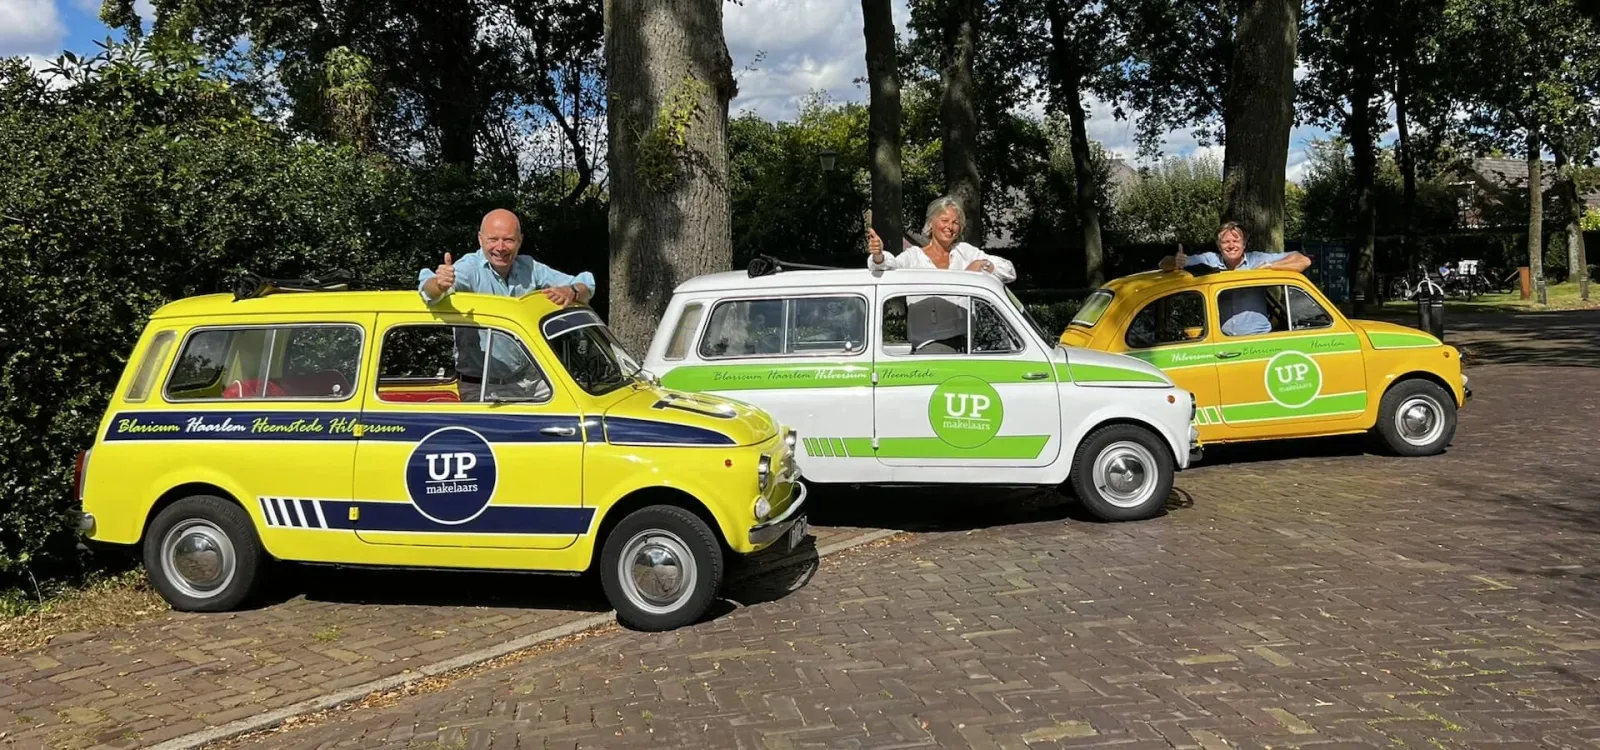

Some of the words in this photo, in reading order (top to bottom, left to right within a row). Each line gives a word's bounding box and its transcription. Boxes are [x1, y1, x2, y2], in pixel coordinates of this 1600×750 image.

[1171, 353, 1214, 363] Hilversum
[1242, 347, 1283, 356] Blaricum
[1310, 340, 1345, 349] Haarlem
[714, 371, 762, 381] Blaricum
[767, 370, 811, 380] Haarlem
[814, 369, 867, 380] Hilversum
[882, 369, 934, 379] Heemstede
[1274, 363, 1309, 383] UP
[944, 392, 991, 417] UP
[118, 419, 180, 433] Blaricum
[185, 416, 247, 433] Haarlem
[251, 417, 324, 434] Heemstede
[328, 417, 406, 434] Hilersum
[942, 419, 991, 431] makelaars
[425, 452, 477, 480] UP
[426, 481, 479, 494] makelaars
